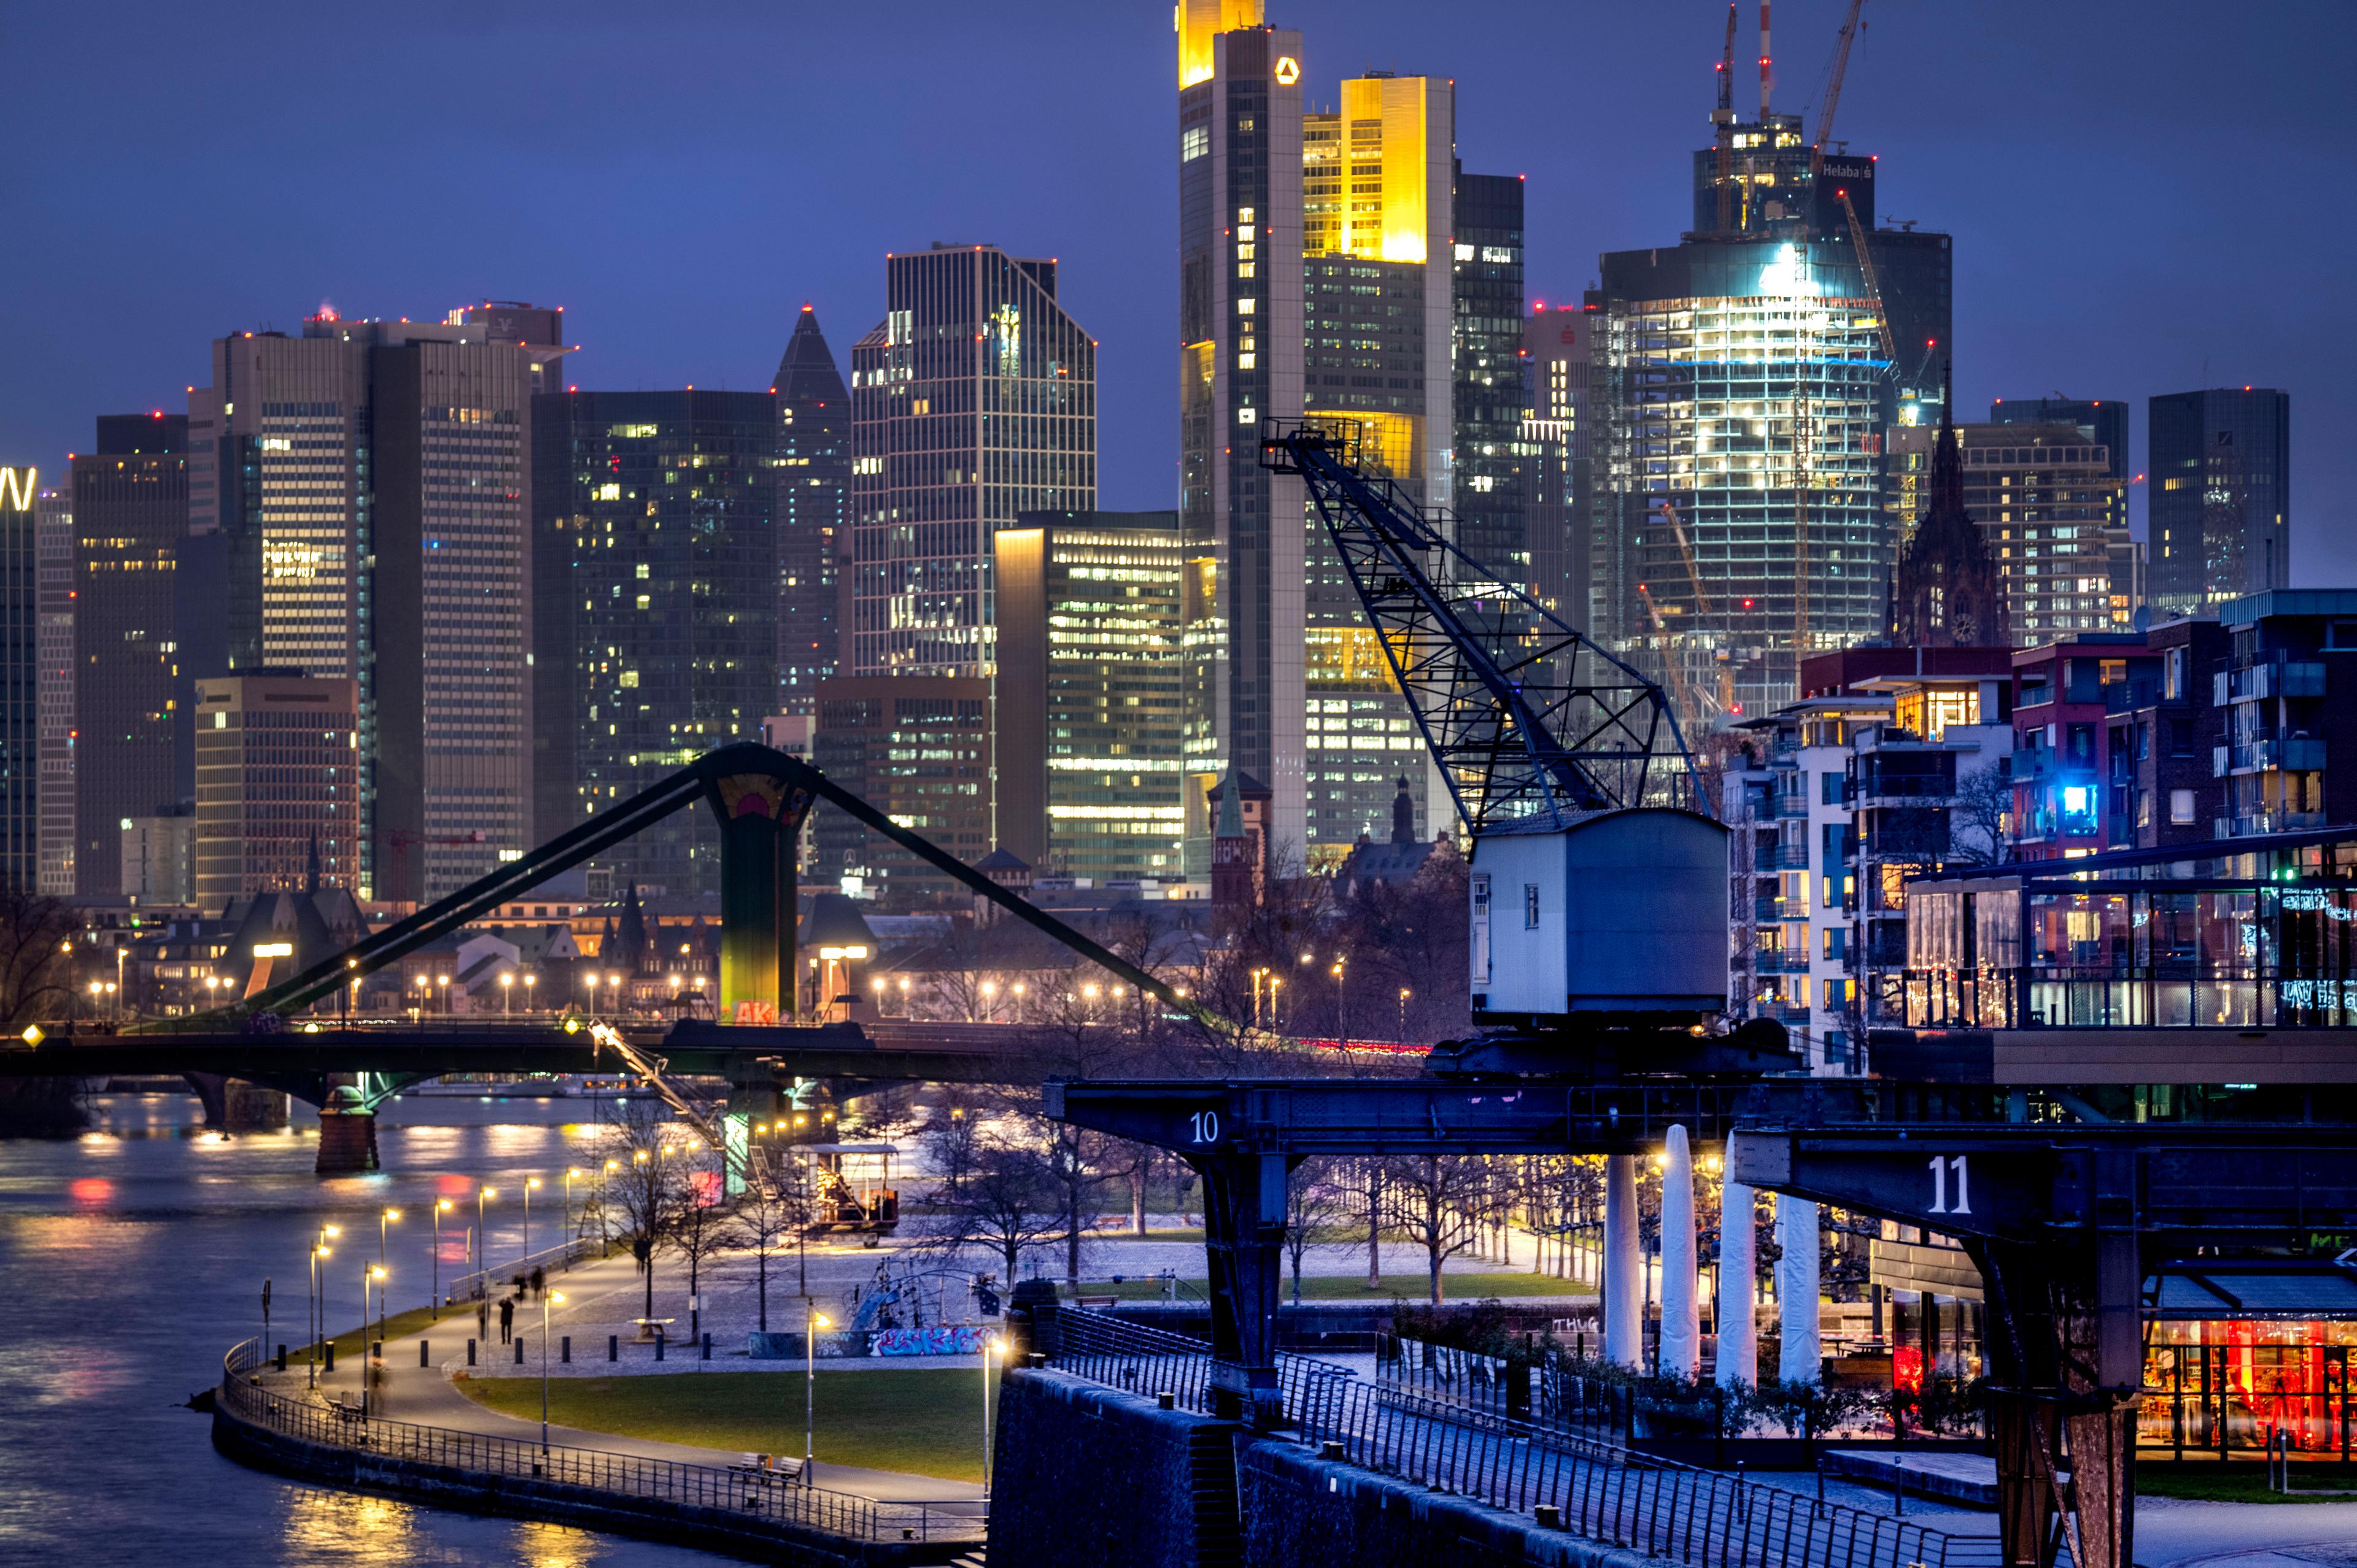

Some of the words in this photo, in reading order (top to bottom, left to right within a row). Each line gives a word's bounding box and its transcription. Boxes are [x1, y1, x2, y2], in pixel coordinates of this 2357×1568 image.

[1823, 164, 1859, 178] Helaba
[1190, 1111, 1218, 1143] 10
[1927, 1155, 1972, 1214] 11
[1553, 1316, 1600, 1334] THUG
